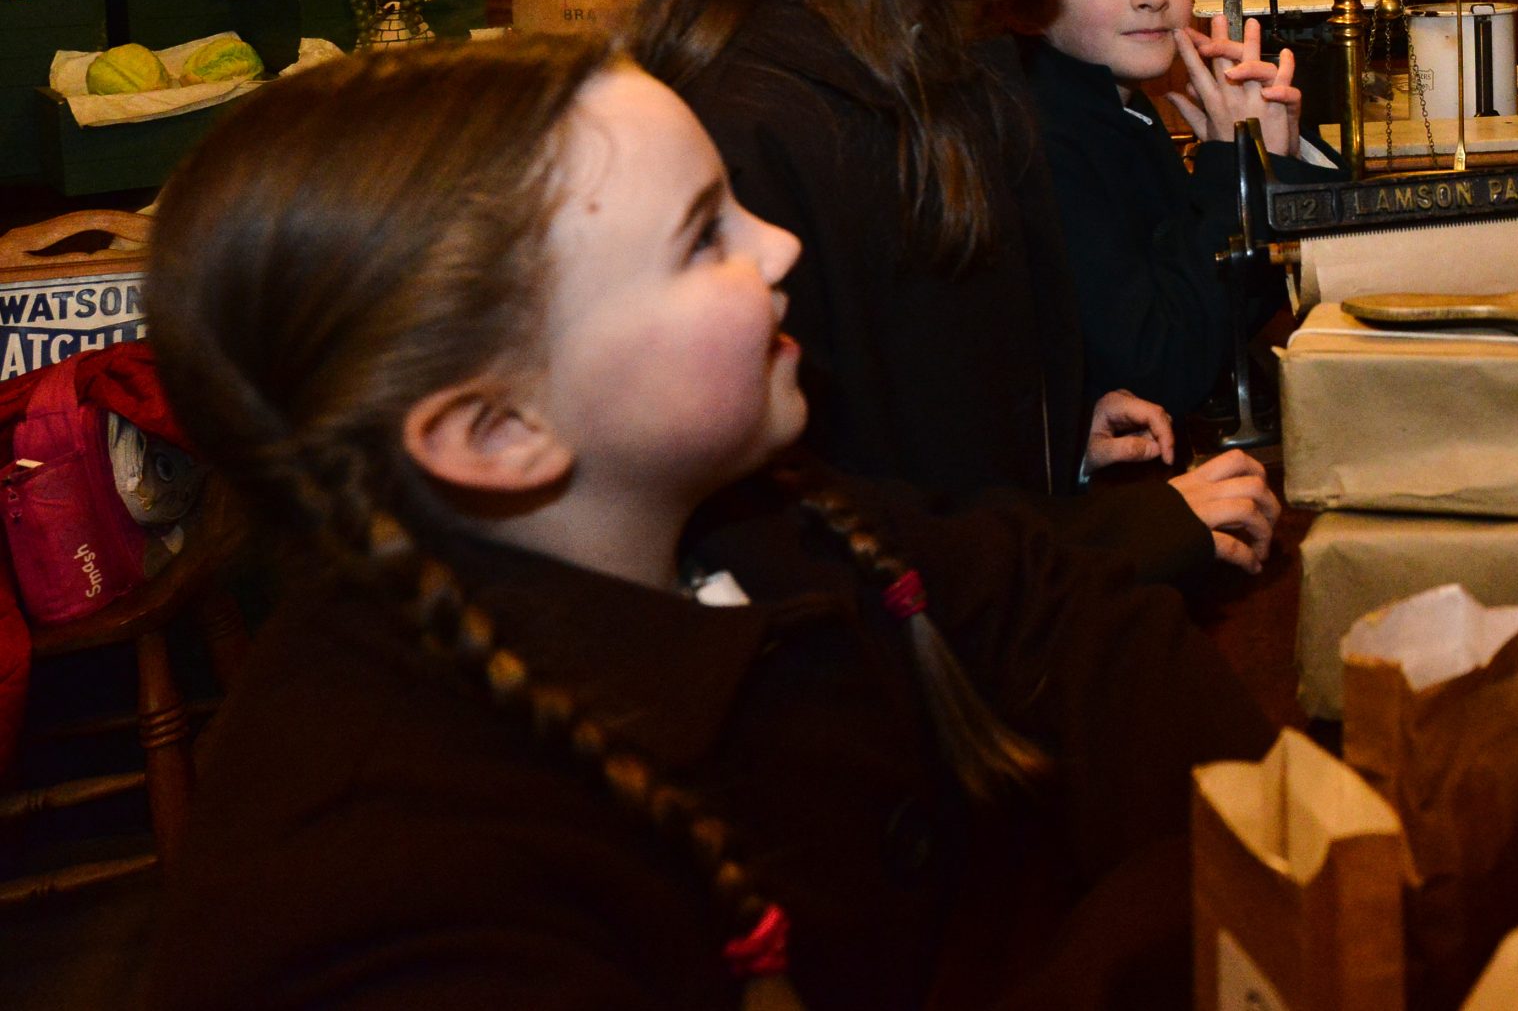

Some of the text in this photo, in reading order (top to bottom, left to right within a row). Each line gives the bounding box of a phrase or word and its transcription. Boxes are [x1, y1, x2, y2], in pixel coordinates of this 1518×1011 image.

[1287, 199, 1318, 221] 12
[1353, 183, 1475, 214] LAMSON
[73, 543, 103, 598] Smash
